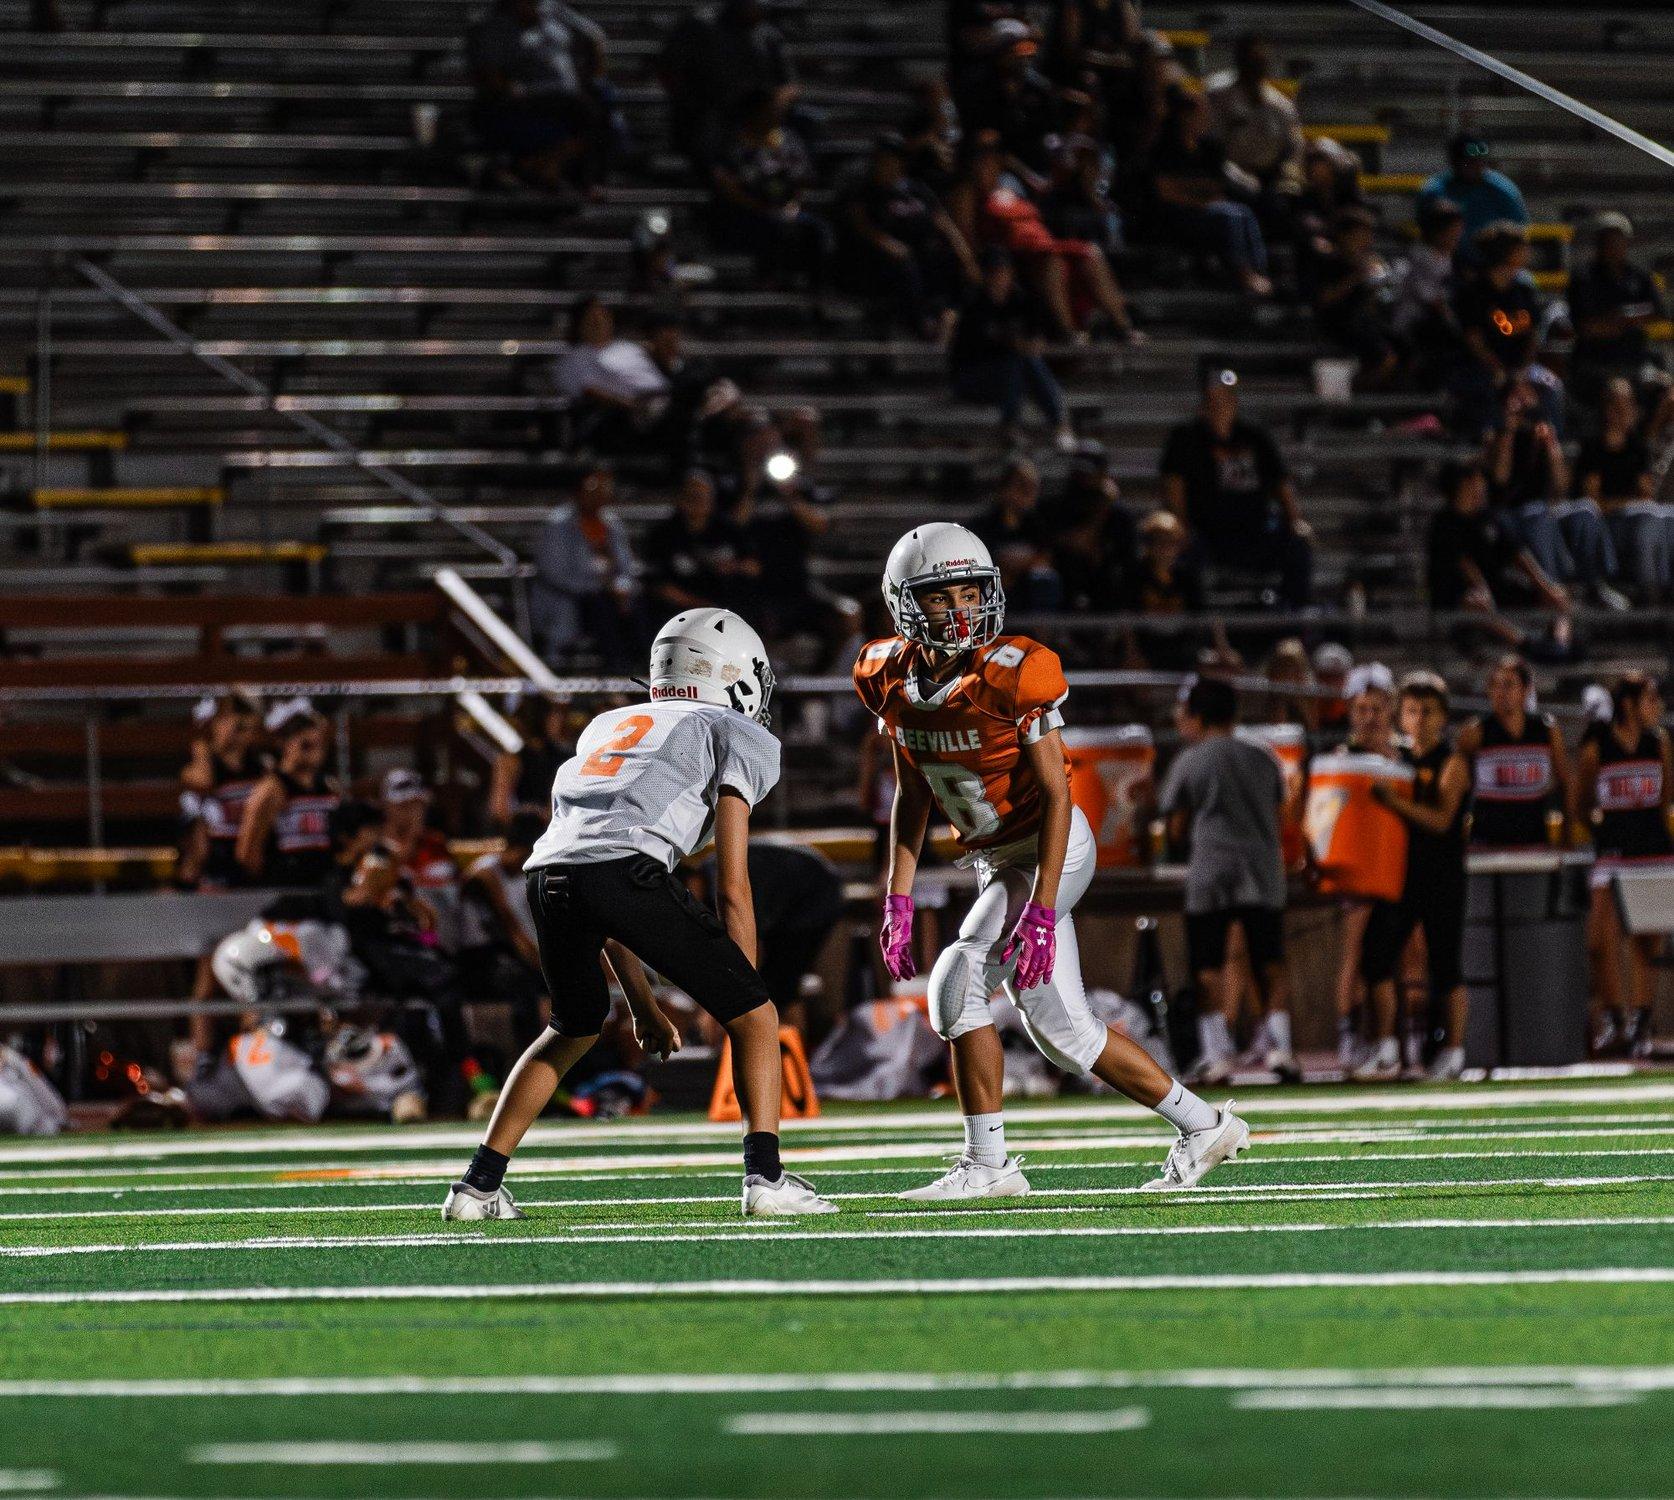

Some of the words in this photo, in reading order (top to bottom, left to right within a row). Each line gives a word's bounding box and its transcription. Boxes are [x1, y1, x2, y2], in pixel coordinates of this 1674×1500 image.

[652, 685, 698, 699] Riddell
[578, 715, 655, 777] 2
[921, 763, 1000, 842] 8
